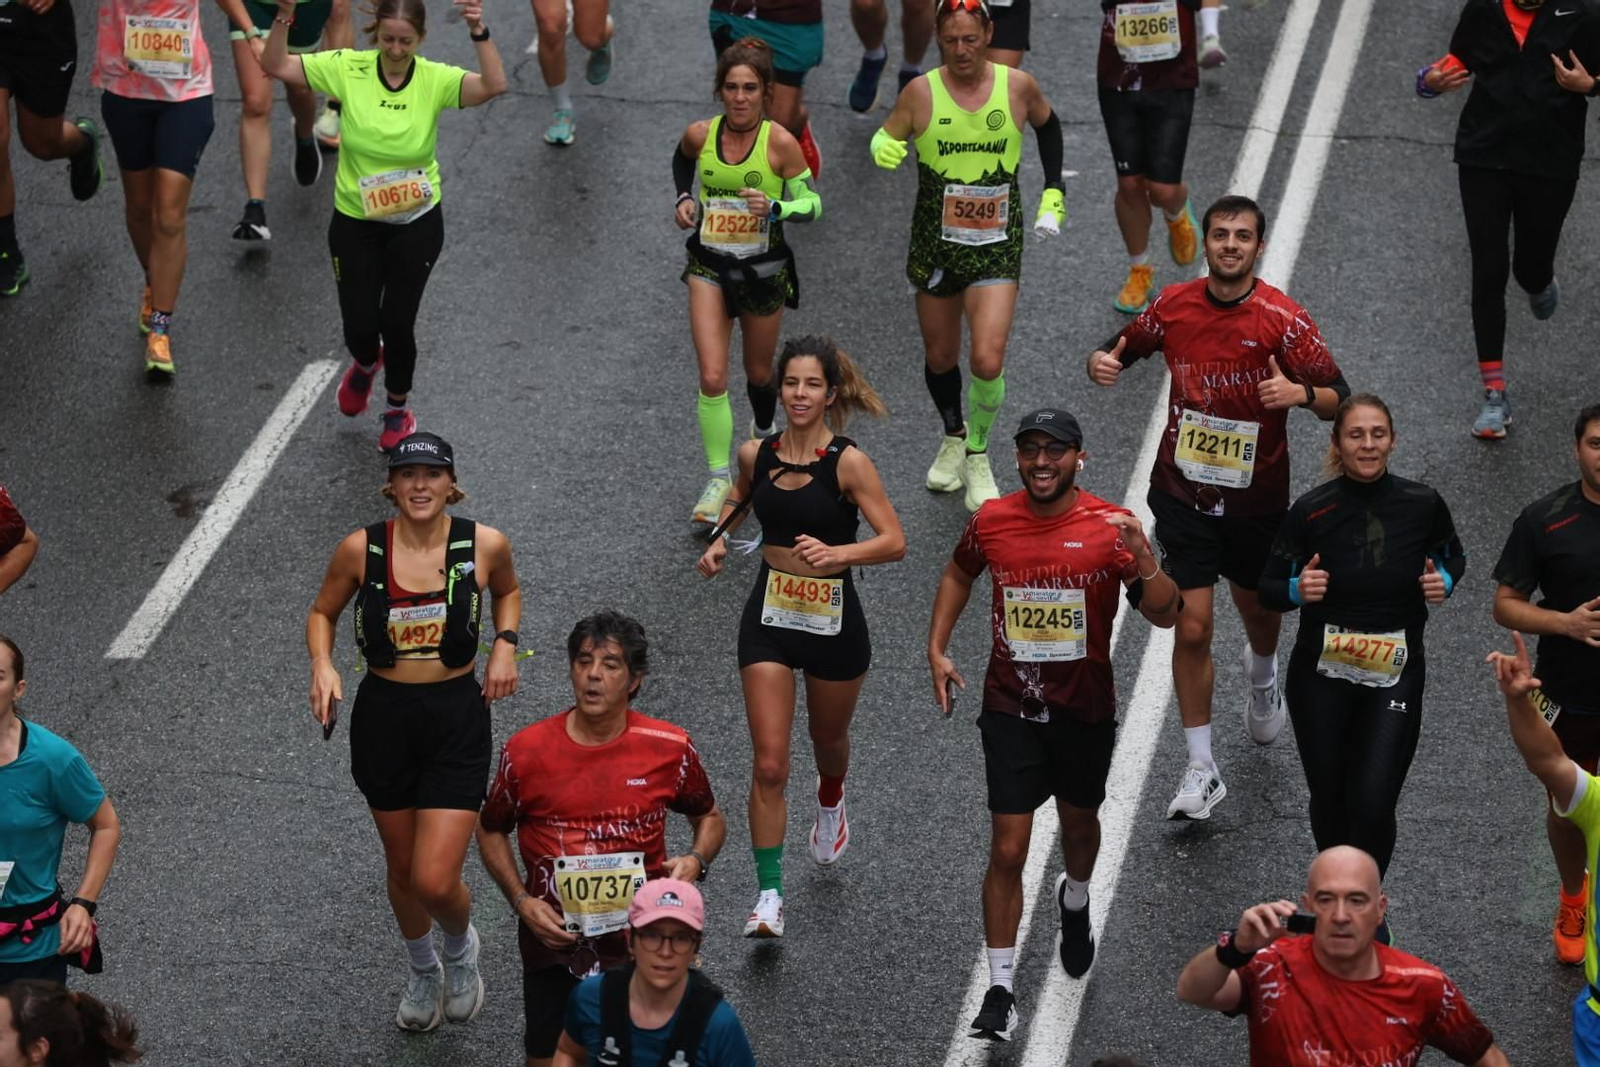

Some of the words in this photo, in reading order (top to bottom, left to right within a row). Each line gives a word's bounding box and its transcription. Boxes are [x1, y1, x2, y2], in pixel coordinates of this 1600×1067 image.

[1120, 16, 1168, 37] 13266
[131, 31, 181, 52] 10840
[937, 138, 1008, 156] DEPORTEMANIA
[368, 182, 422, 208] 10678
[954, 200, 996, 219] 5249
[706, 213, 759, 233] 12522
[1202, 366, 1273, 388] MARATO
[407, 442, 439, 454] TENZING
[1186, 428, 1241, 458] 12211
[1009, 563, 1071, 583] MEDIO
[774, 575, 831, 604] 14493
[1011, 606, 1073, 629] 12245
[388, 622, 447, 646] 1492
[1331, 636, 1395, 662] 14277
[627, 778, 647, 786] HOKA
[563, 875, 632, 900] 10737
